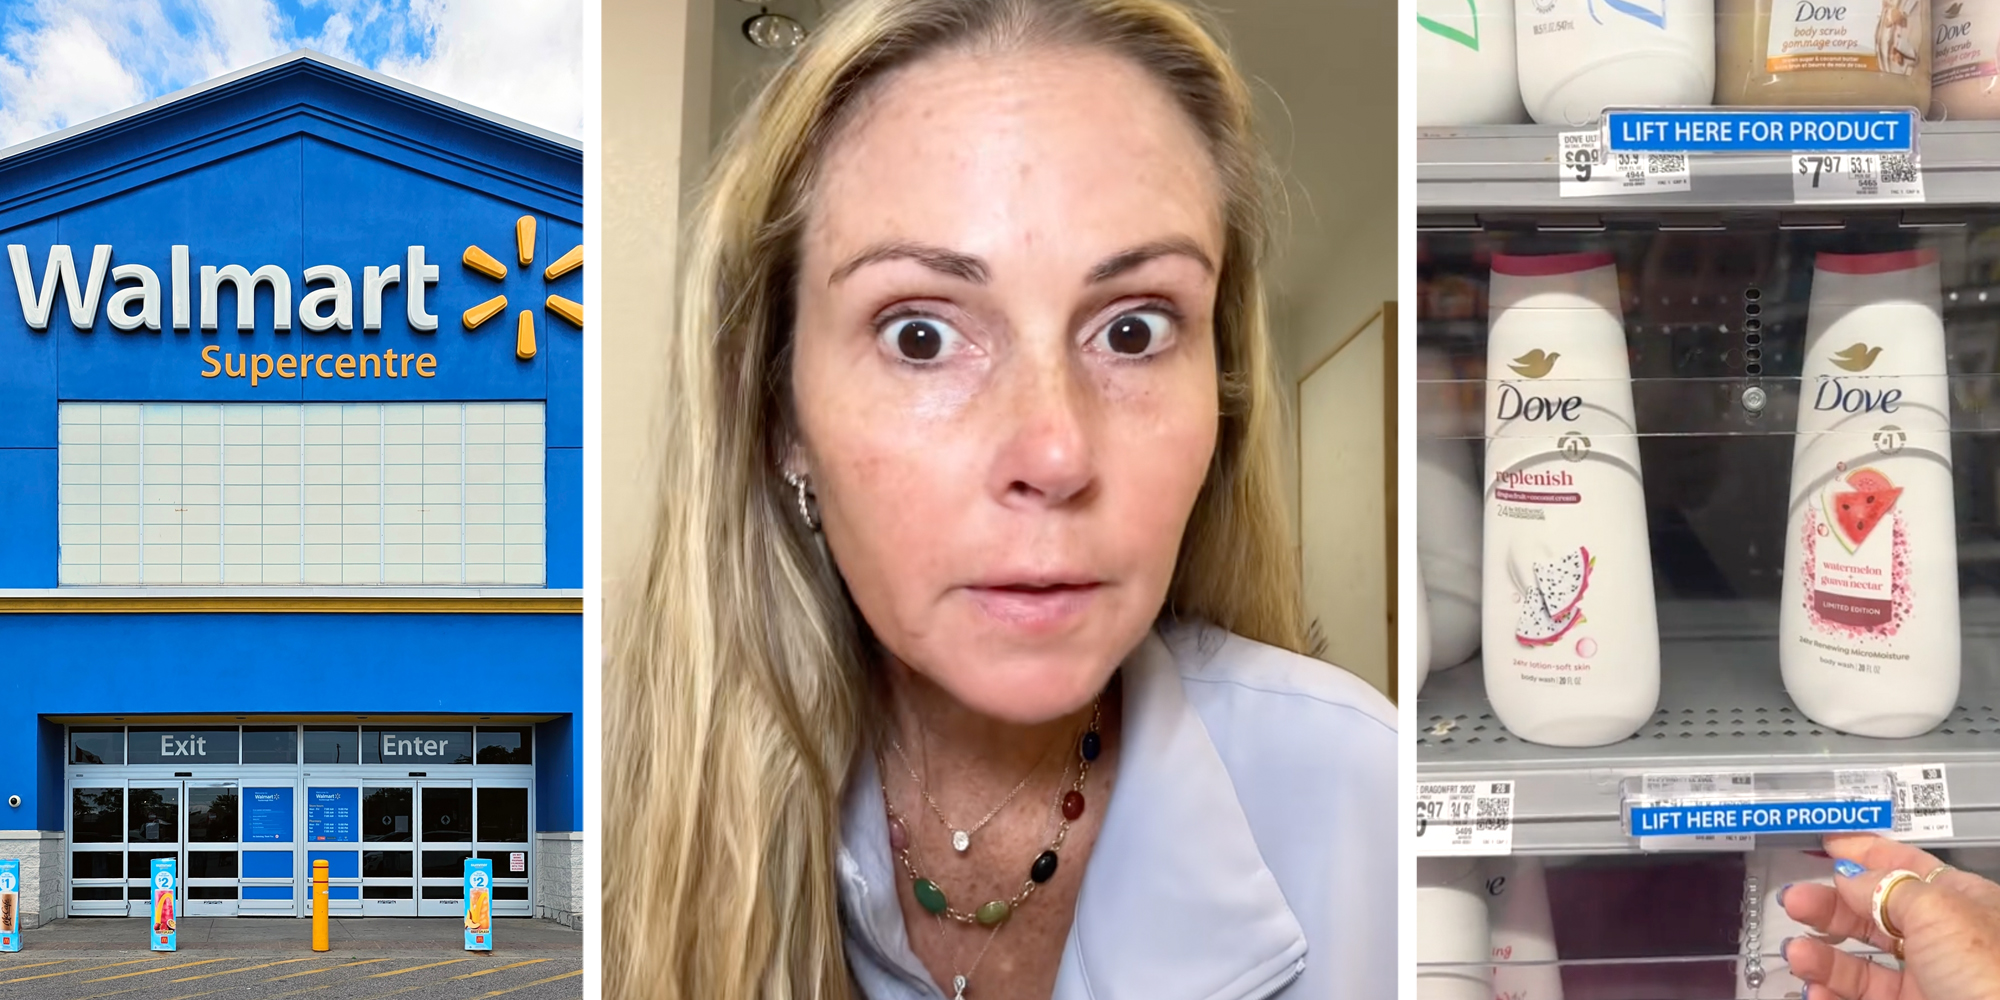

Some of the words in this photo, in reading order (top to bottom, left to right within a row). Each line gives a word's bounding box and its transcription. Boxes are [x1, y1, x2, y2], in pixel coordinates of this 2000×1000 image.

[1795, 0, 1847, 22] Dove
[1794, 27, 1817, 38] body
[1819, 26, 1847, 36] scrub
[1936, 21, 1971, 45] Dove
[1782, 39, 1831, 52] gommage
[1832, 38, 1859, 48] corps
[1950, 40, 1972, 53] scrub
[1959, 50, 1982, 60] corps
[1564, 135, 1583, 143] DOVE
[1622, 121, 1669, 142] LIFT
[1675, 121, 1732, 142] HERE
[1739, 121, 1784, 142] FOR
[1790, 121, 1899, 141] PRODUCT
[7, 244, 439, 332] Walmart
[201, 345, 437, 386] Supercentre
[1814, 374, 1902, 413] Dove
[1497, 383, 1582, 422] Dove
[1496, 469, 1574, 489] replenish
[1497, 504, 1508, 517] 24
[1823, 561, 1882, 576] watermelon
[1820, 575, 1849, 587] guava
[1850, 580, 1884, 591] nectar
[1823, 601, 1849, 612] LIMITED
[1851, 605, 1881, 615] EDITION
[1814, 640, 1849, 655] Renewing
[1851, 646, 1910, 661] MicroMoisture
[1529, 660, 1571, 671] lotion-soft
[1574, 663, 1590, 671] skin
[1820, 656, 1836, 667] body
[1837, 660, 1854, 669] wash
[1873, 665, 1881, 674] OZ
[1521, 673, 1537, 682] body
[161, 735, 206, 756] Exit
[383, 735, 449, 756] Enter
[1420, 785, 1458, 793] DRAGONFRT
[1642, 812, 1682, 830] LIFT
[1687, 810, 1737, 828] HERE
[1742, 809, 1782, 827] FOR
[1787, 807, 1882, 825] PRODUCT
[2, 878, 10, 889] $1
[158, 877, 169, 888] $2
[473, 877, 484, 887] $2
